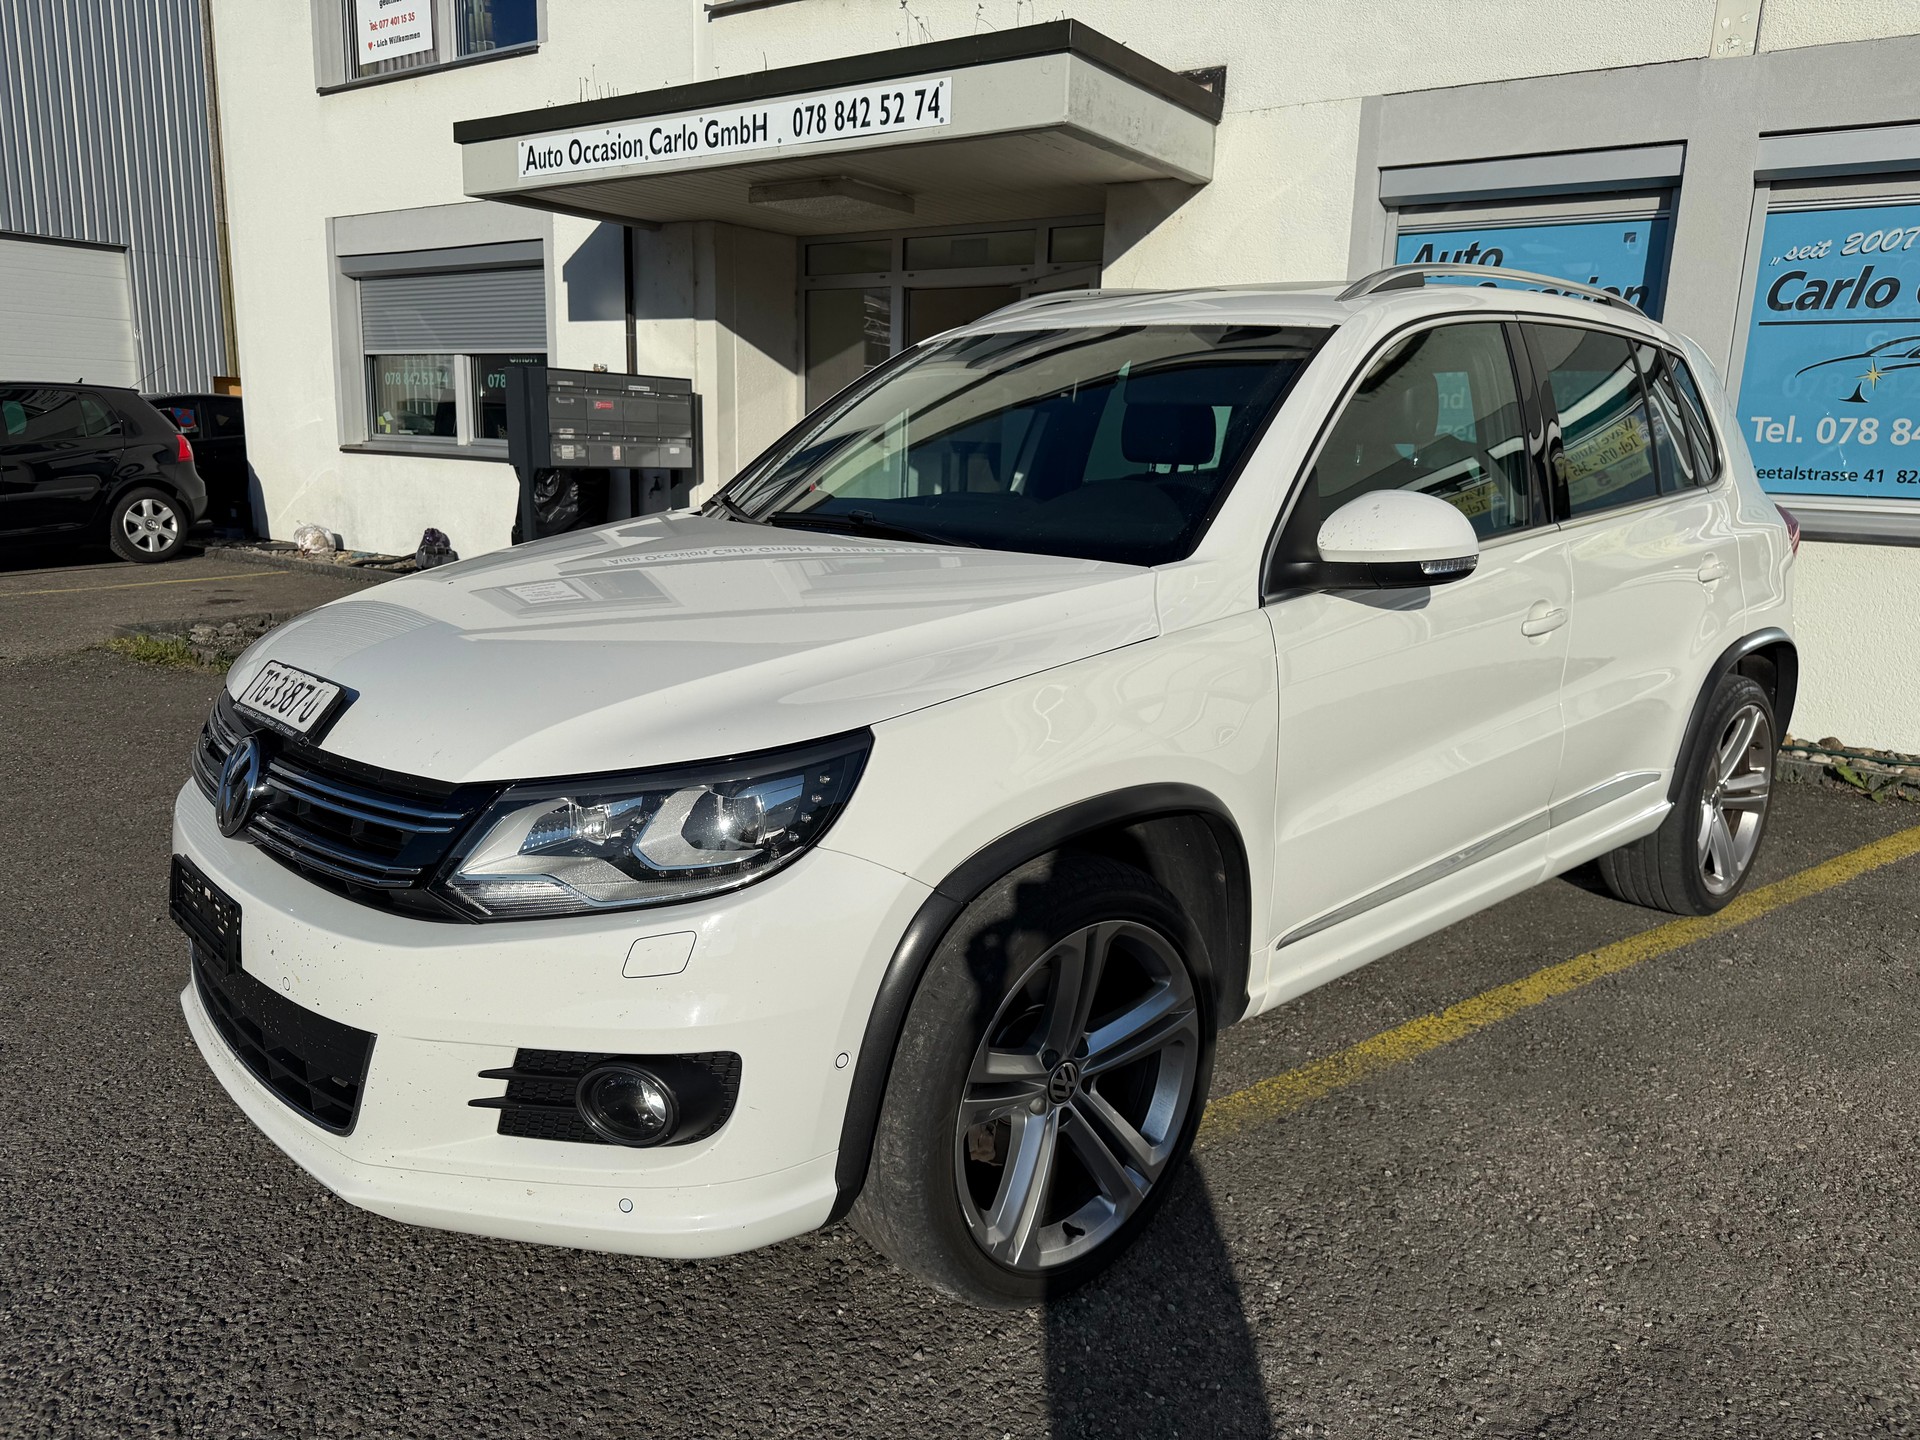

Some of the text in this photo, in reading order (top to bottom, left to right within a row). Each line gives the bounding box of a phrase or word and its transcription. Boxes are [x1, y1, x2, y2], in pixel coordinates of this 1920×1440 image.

[379, 18, 389, 29] 077
[390, 16, 400, 26] 401
[401, 14, 407, 24] 15
[408, 12, 415, 22] 35
[389, 31, 421, 44] Willkommen
[525, 86, 940, 171] Auto Occasion Carlo GmbH 078 842 52 74
[1840, 225, 1920, 257] 2007
[1766, 264, 1901, 312] Carlo
[384, 372, 401, 385] 078
[488, 373, 506, 388] 078
[1750, 415, 1803, 443] Tel.
[1816, 417, 1880, 445] 078
[1753, 465, 1920, 484] eetalstrasse 41 82
